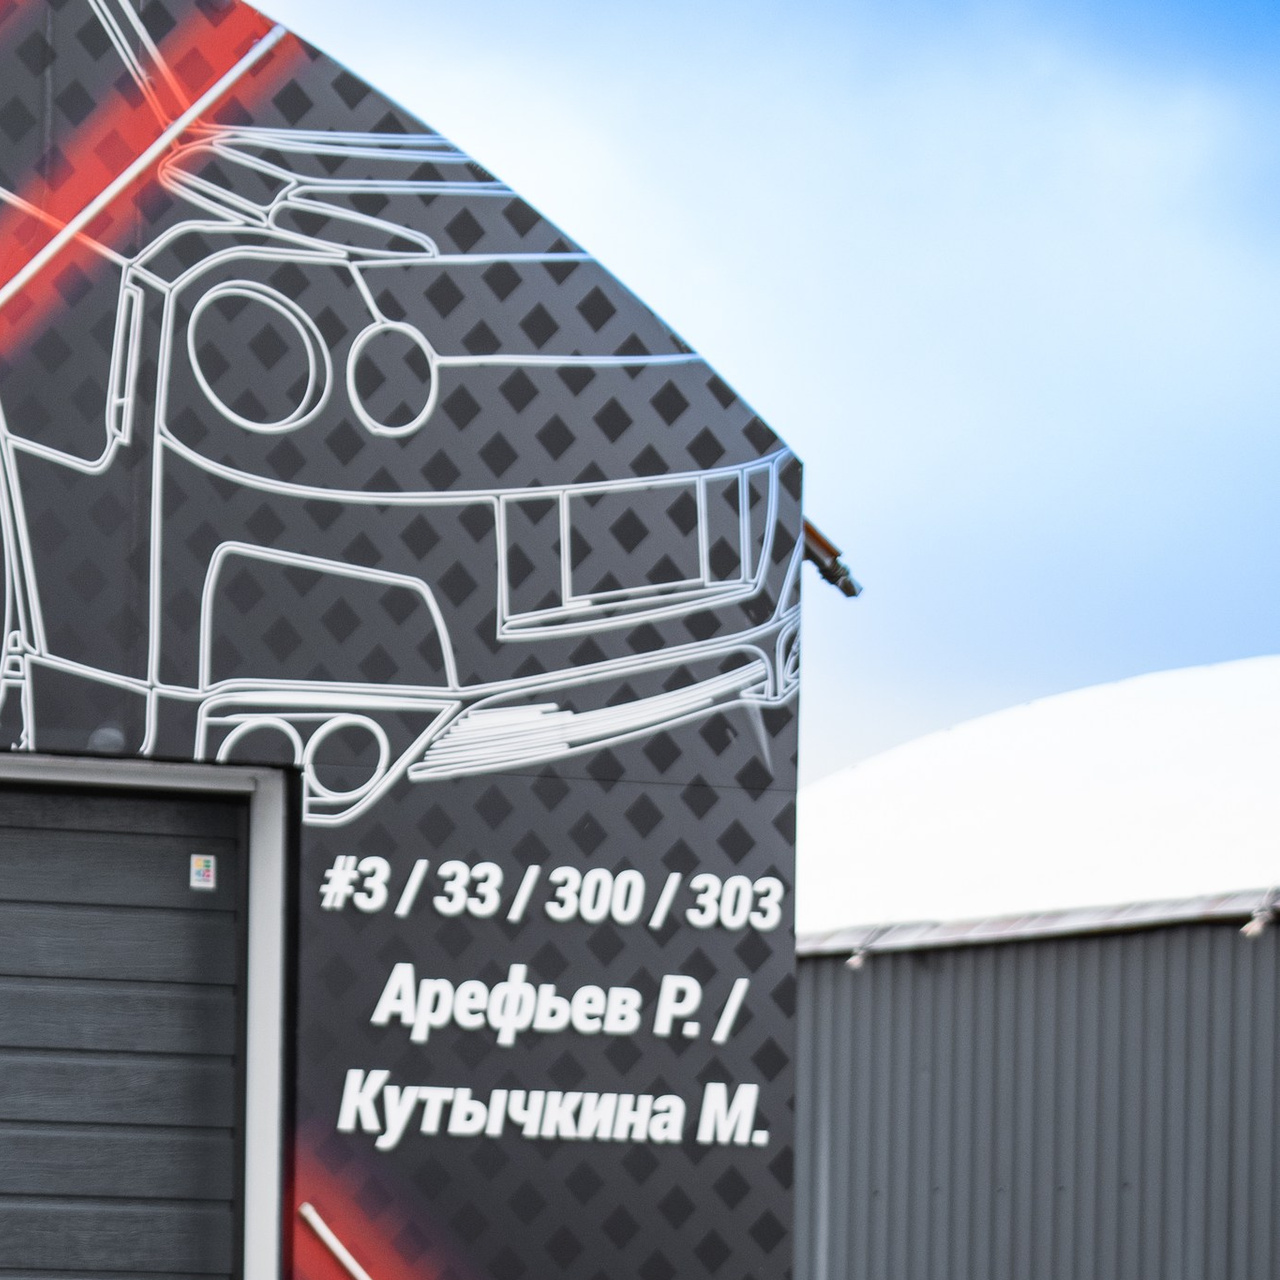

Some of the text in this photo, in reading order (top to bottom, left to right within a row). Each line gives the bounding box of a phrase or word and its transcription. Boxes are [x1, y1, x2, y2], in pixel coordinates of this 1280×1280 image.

[319, 855, 784, 931] #3 / 33 / 300 / 303
[370, 962, 750, 1047] Арефьев Р. /
[336, 1068, 769, 1150] Кутычкина М.
